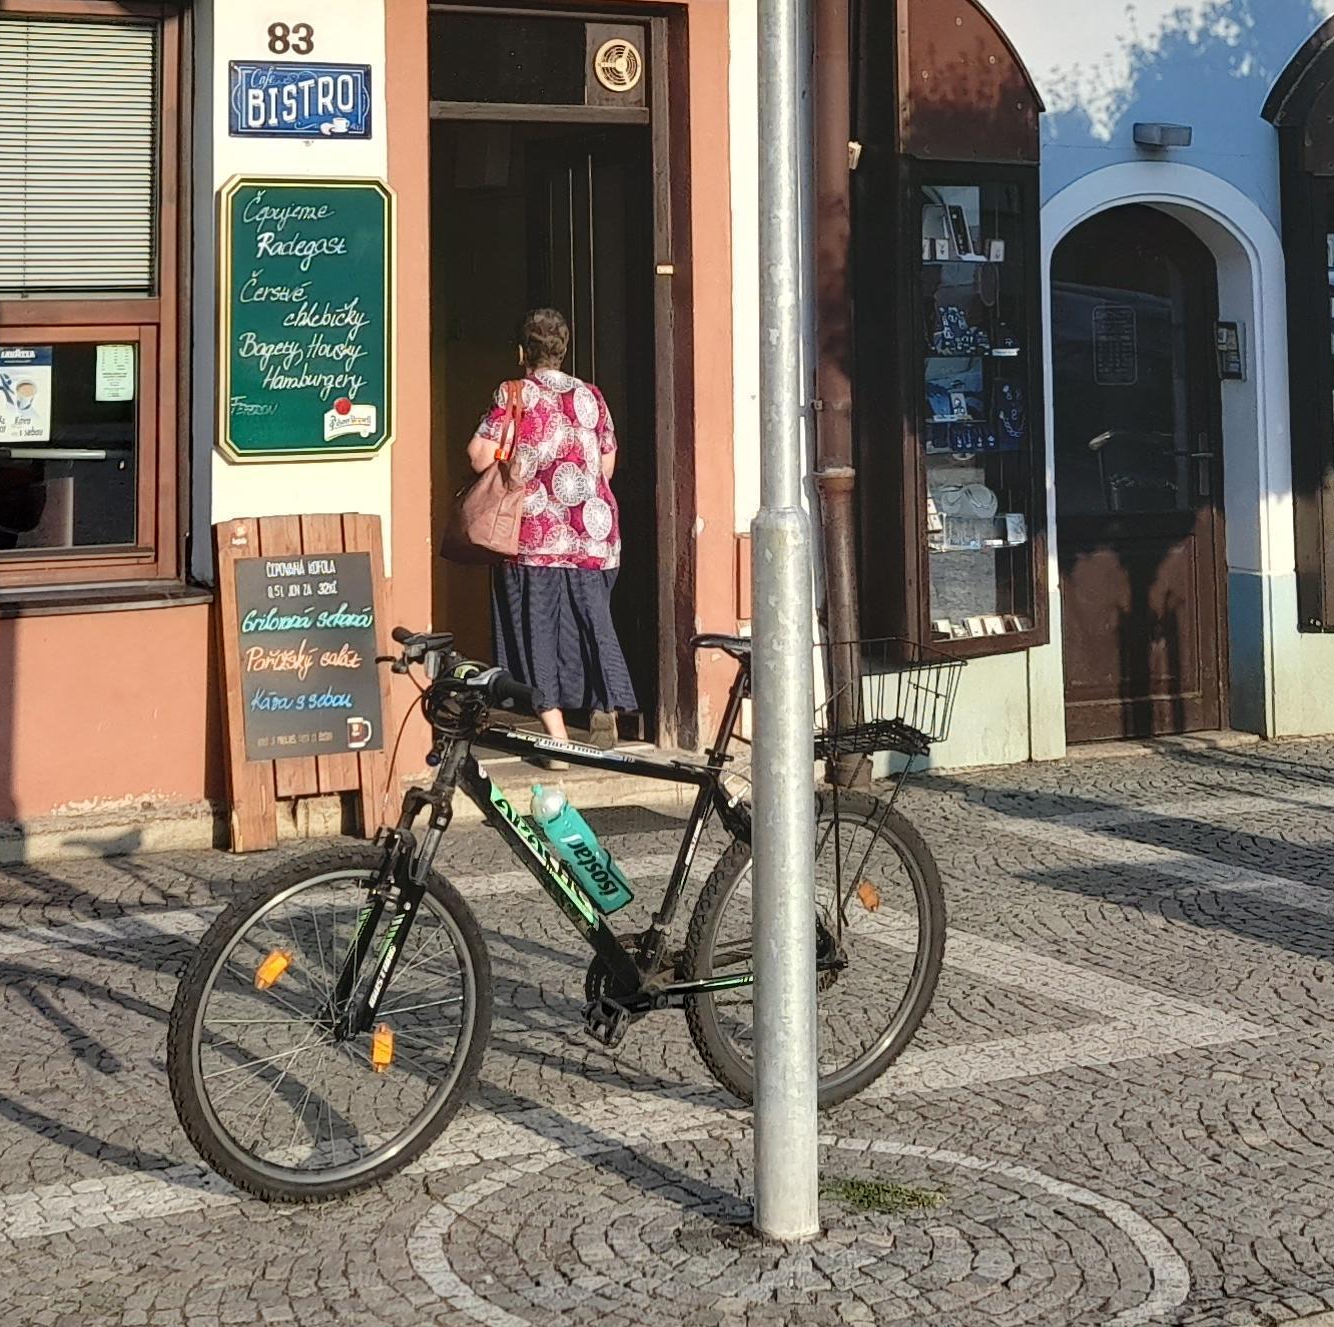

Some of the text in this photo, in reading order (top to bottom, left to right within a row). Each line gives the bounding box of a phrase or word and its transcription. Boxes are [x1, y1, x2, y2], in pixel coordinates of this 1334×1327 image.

[268, 23, 314, 55] 83
[248, 74, 354, 128] BISTRO
[256, 232, 347, 271] Radegast
[240, 269, 312, 302] Čerstvé
[283, 297, 370, 341] chlebíčky
[262, 363, 367, 401] Hamburgery
[302, 583, 313, 596] ZA
